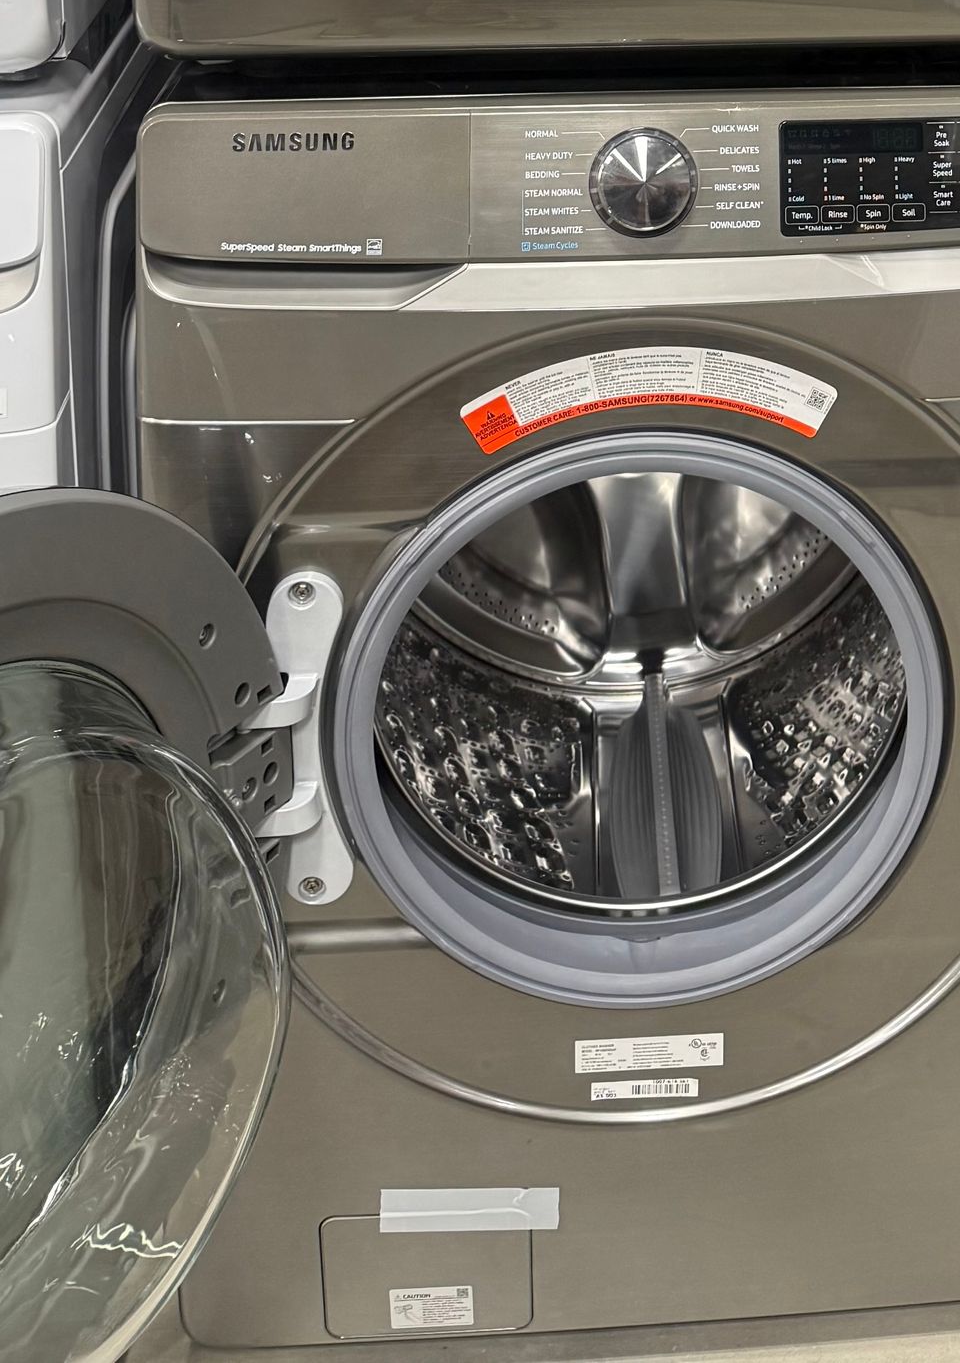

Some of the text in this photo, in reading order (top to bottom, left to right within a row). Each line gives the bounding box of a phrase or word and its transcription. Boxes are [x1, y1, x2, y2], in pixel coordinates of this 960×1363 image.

[711, 124, 760, 134] QUICK WASH
[525, 130, 558, 138] NORMAL
[231, 131, 355, 153] SAMSUNG
[934, 139, 950, 147] Soak
[719, 146, 760, 155] DELICATES
[525, 151, 573, 160] HEAVY DUTY
[731, 164, 760, 173] TOWELS
[933, 161, 952, 170] Super
[525, 170, 560, 179] BEDDING
[932, 169, 953, 178] Speed
[714, 183, 760, 192] RINSE+SPIN
[524, 188, 583, 198] STEAM NORMAL
[716, 201, 735, 210] SELF
[524, 206, 579, 216] STEAM WHITES
[828, 210, 848, 218] Rinse
[866, 209, 882, 218] Spin
[902, 208, 916, 217] Soil
[792, 212, 813, 220] Temp.
[710, 219, 761, 230] DOWNLOADED
[524, 225, 584, 235] STEAM SANITIZE
[220, 241, 275, 253] SuperSpeed
[277, 243, 307, 252] Steam
[308, 243, 362, 255] SmartThings
[532, 241, 578, 251] Steam Cycles
[505, 380, 522, 391] NEVER
[514, 416, 553, 437] CUSTOMER
[553, 409, 575, 423] CARE:
[576, 393, 688, 415] 1-800-SAMSUNG(7267864)
[697, 396, 785, 423] www.samsung.com/support
